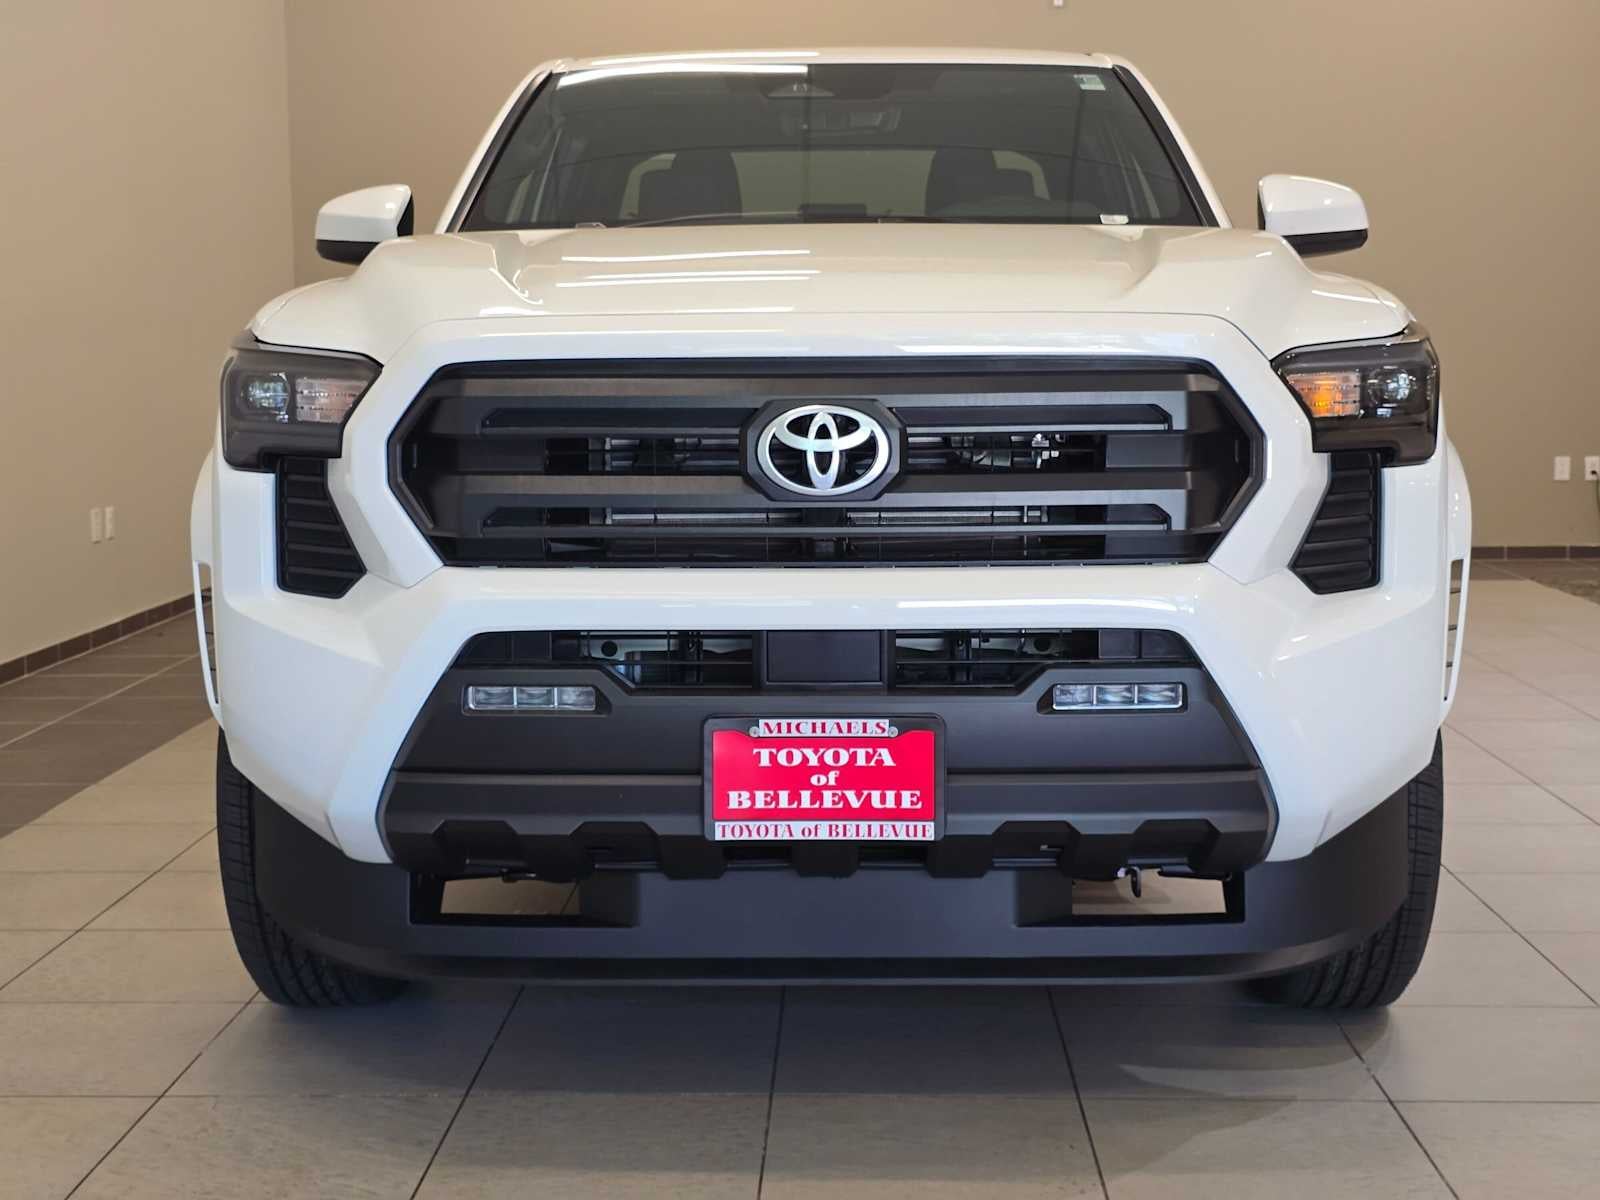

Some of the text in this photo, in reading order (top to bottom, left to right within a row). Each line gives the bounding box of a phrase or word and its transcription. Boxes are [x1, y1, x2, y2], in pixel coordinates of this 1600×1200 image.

[763, 721, 888, 735] MICHAELS
[753, 748, 896, 767] TOYOTA
[810, 770, 840, 786] of
[727, 790, 923, 810] BELLEVUE
[717, 823, 933, 839] TOYOTA of BELLEVUE
